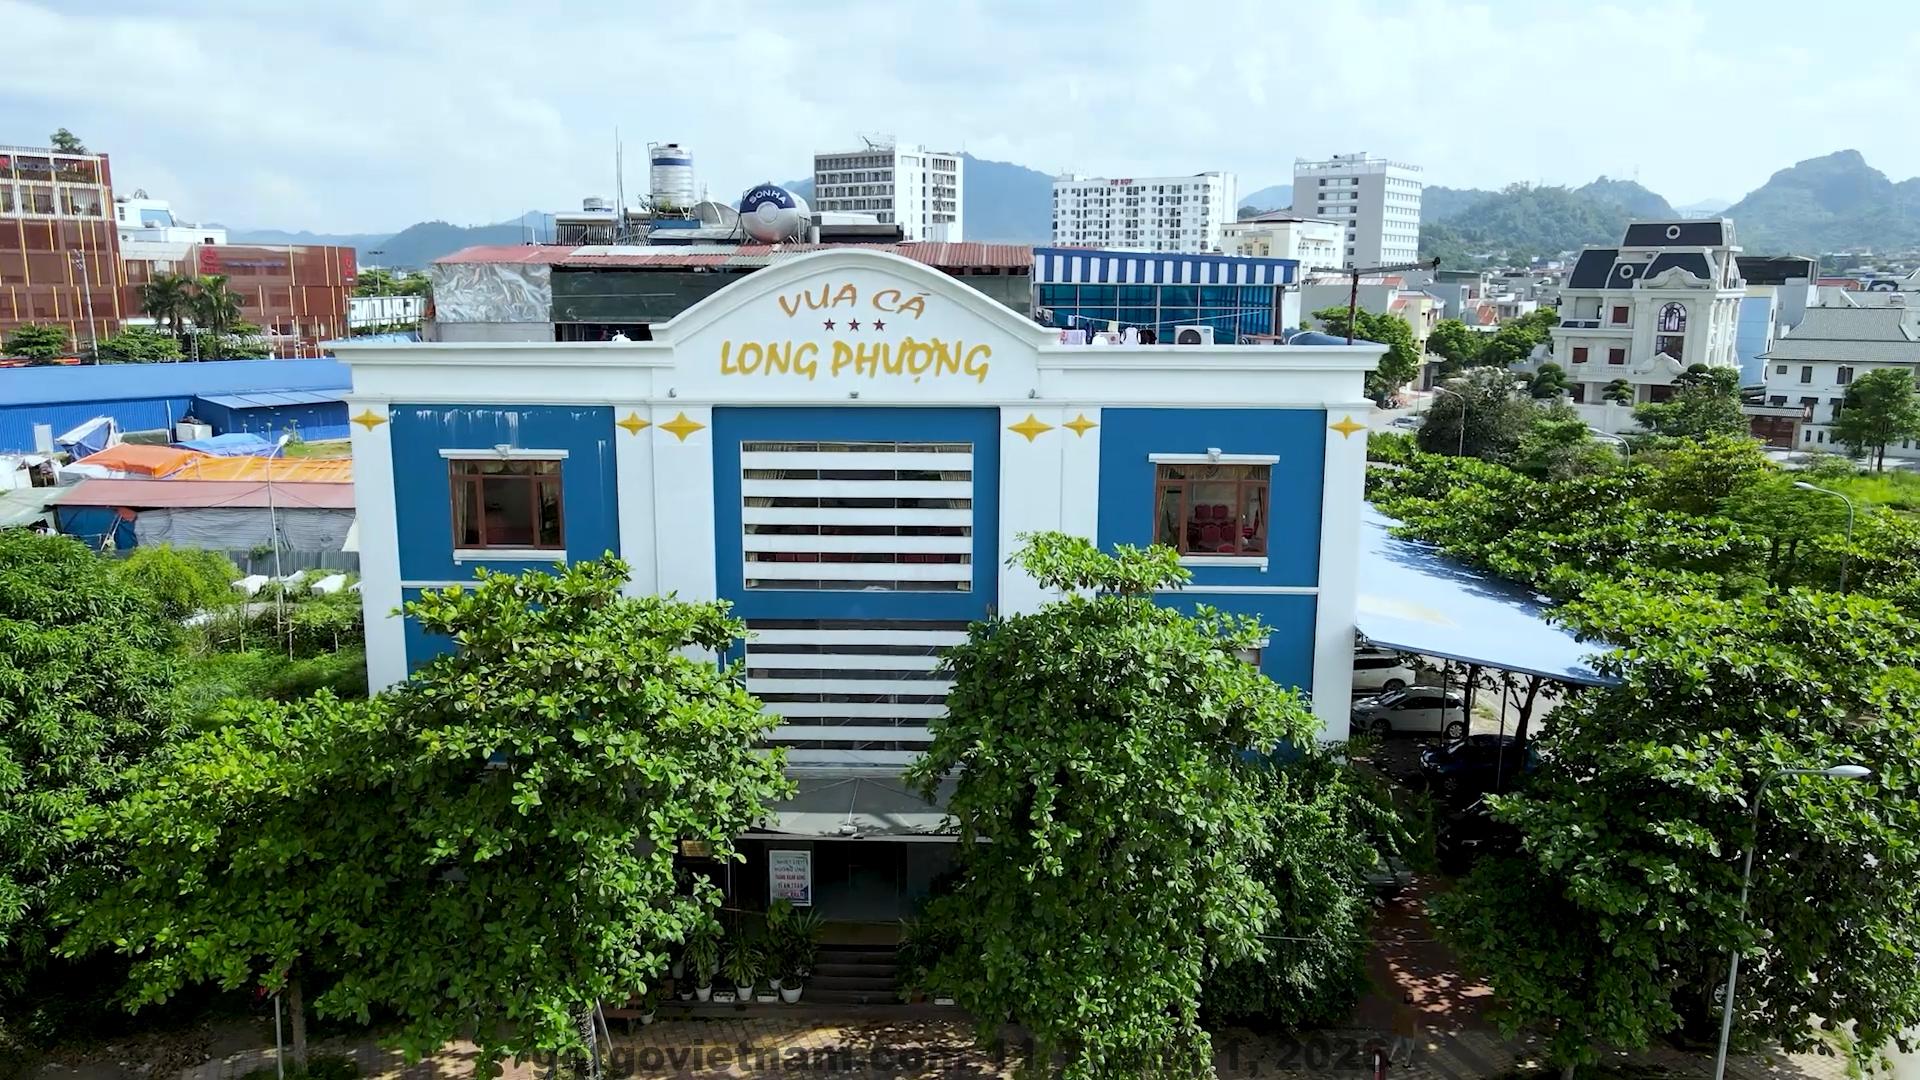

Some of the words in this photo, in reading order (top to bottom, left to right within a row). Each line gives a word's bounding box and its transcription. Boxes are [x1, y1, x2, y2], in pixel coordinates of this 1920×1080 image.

[749, 189, 786, 205] SONHA
[778, 283, 857, 318] VUA
[720, 339, 819, 382] LONG
[831, 336, 992, 384] PHƯỢNG
